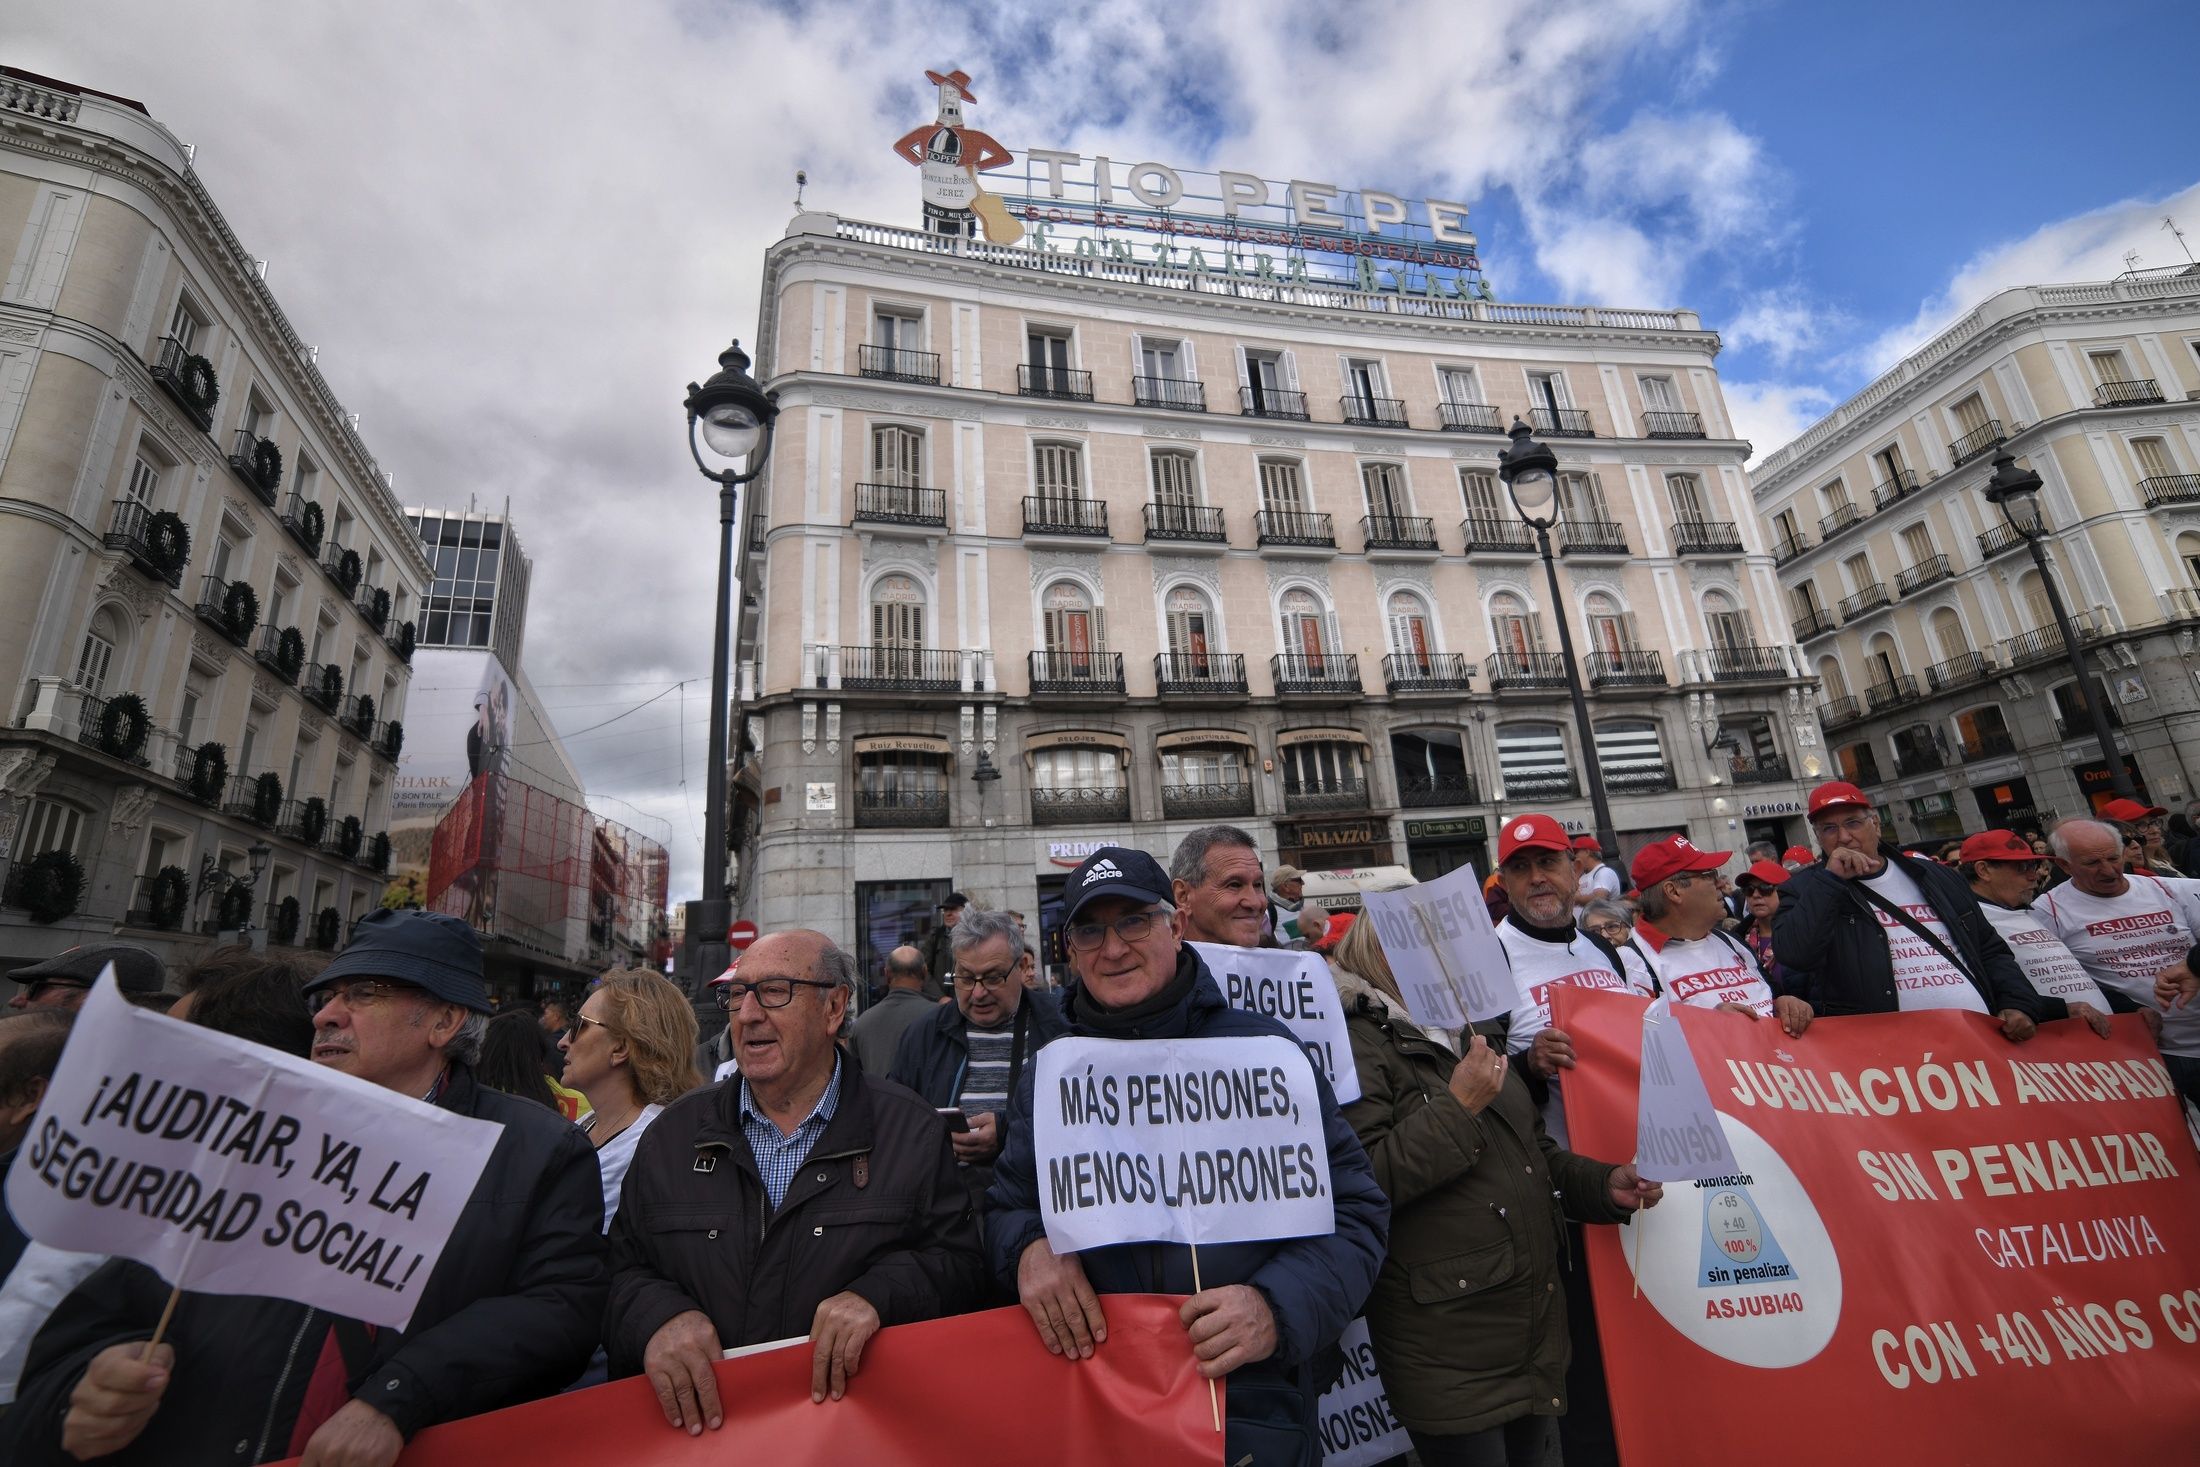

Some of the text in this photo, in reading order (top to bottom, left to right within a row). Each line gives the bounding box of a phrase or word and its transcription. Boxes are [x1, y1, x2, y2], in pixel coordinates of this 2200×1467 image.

[937, 188, 964, 198] JEREZ
[1028, 148, 1478, 246] TIO PEPE
[928, 207, 945, 217] FINO
[948, 211, 962, 220] MUY
[1025, 205, 1084, 226] SOL
[1095, 210, 1130, 229] DE
[1302, 235, 1480, 270] EMBOTELLADO
[1353, 256, 1497, 301] BYASS
[1049, 600, 1083, 608] MADRID
[1170, 602, 1202, 611] MADRID
[870, 741, 936, 751] Ruiz Revuelto
[1057, 734, 1097, 743] RELOJES
[393, 775, 452, 788] SHARK
[2083, 766, 2132, 782] Ora
[401, 792, 420, 800] SON
[422, 792, 441, 800] TALE
[1744, 801, 1801, 816] SEPHORA
[1303, 829, 1372, 847] PALAZZO
[1082, 870, 1123, 887] adidas
[1317, 870, 1376, 882] Palazzo
[1316, 896, 1361, 908] HELADOS
[2092, 912, 2172, 936] ASJUBI40
[2112, 927, 2163, 941] CATALUNYA
[1908, 967, 1922, 975] DE
[1937, 962, 1956, 971] AÑO
[2029, 966, 2050, 978] SIN
[1895, 973, 1965, 991] TIZADOS
[2040, 975, 2057, 984] CON
[1226, 972, 1325, 1019] PAGUÉ.
[1718, 990, 1749, 1003] BCN
[1725, 1052, 2177, 1117] JUBILACIÓN ANTICIPADA
[1060, 1064, 1299, 1127] MÁS PENSIONES,
[81, 1072, 432, 1221] ¡AUDITAR, YA, LA
[1857, 1132, 2180, 1201] SIN PENALIZAR
[1049, 1143, 1325, 1215] MENOS LADRONES.
[28, 1116, 424, 1293] SEGURIDAD SOCIAL!
[1724, 1195, 1738, 1208] 65
[1733, 1217, 1746, 1230] 40
[1724, 1239, 1757, 1254] 100 %
[1975, 1214, 2166, 1268] CATALUNYA
[1708, 1262, 1790, 1284] sin penalizar
[1706, 1292, 1804, 1320] ASJUBI40
[1871, 1320, 1978, 1389] CON
[1976, 1311, 2052, 1367] +40
[2042, 1296, 2154, 1361] AÑOS
